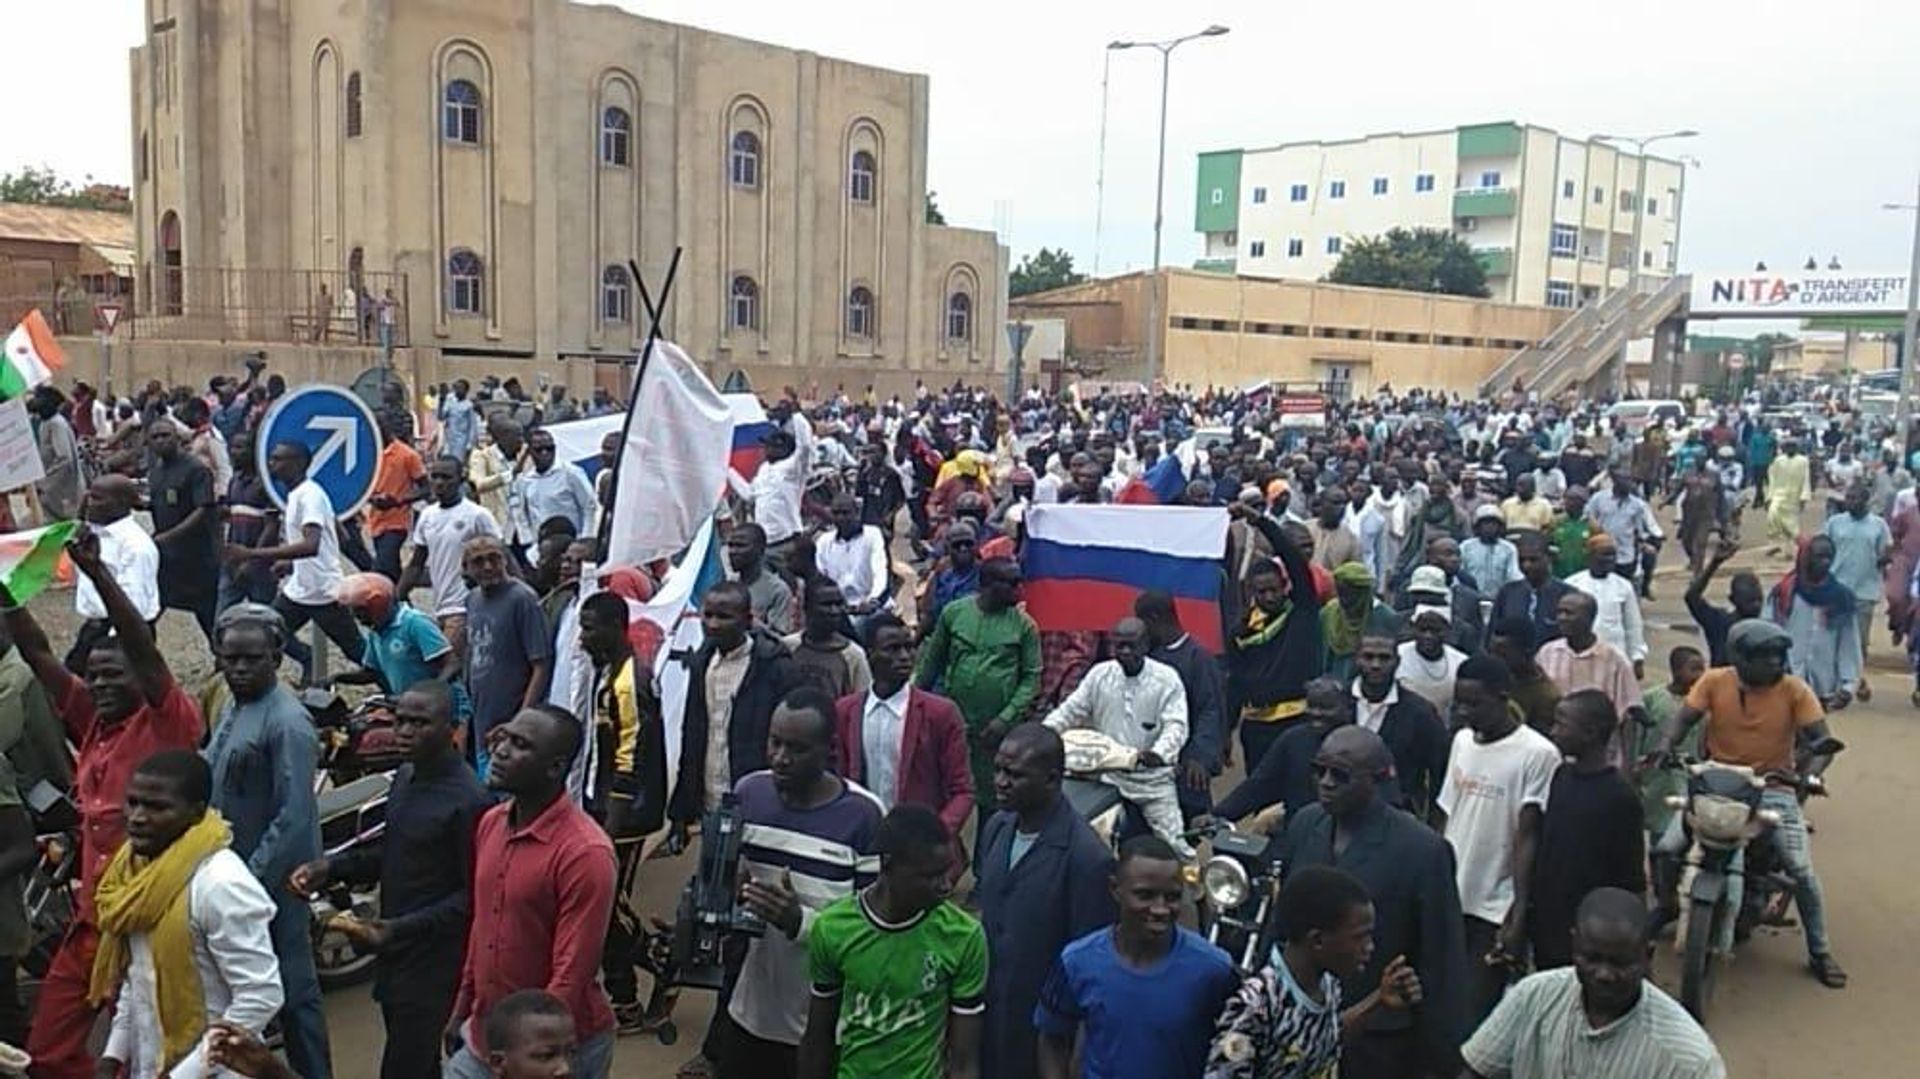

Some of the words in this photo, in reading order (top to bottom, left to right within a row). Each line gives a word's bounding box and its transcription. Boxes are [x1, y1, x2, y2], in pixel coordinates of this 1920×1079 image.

[1712, 279, 1788, 302] NITA
[1803, 278, 1905, 291] TRANSFERT
[1801, 289, 1889, 304] D'ARGENT
